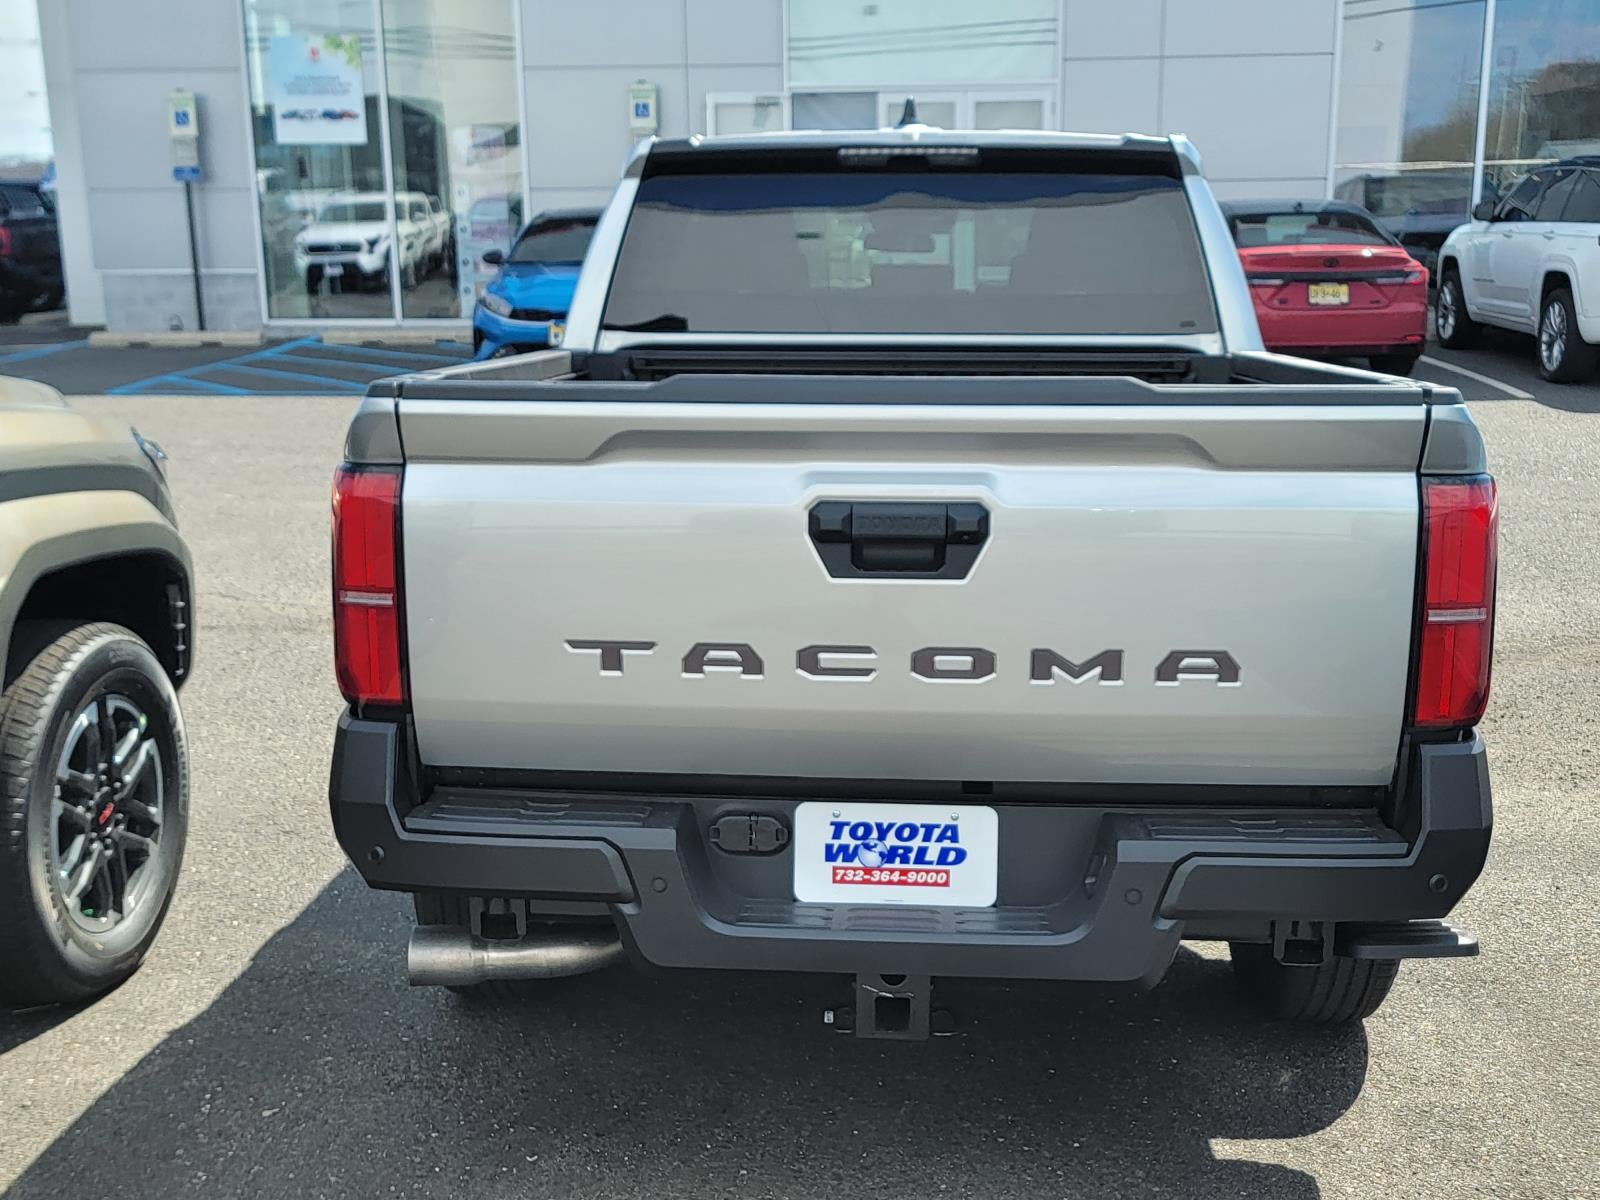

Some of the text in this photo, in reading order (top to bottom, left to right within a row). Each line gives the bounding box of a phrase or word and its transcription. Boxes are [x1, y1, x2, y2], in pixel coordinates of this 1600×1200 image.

[563, 639, 1242, 687] TACOMA
[830, 821, 960, 843] TOYOTA
[825, 839, 968, 867] WORLD
[834, 868, 949, 884] 732-364-9000
